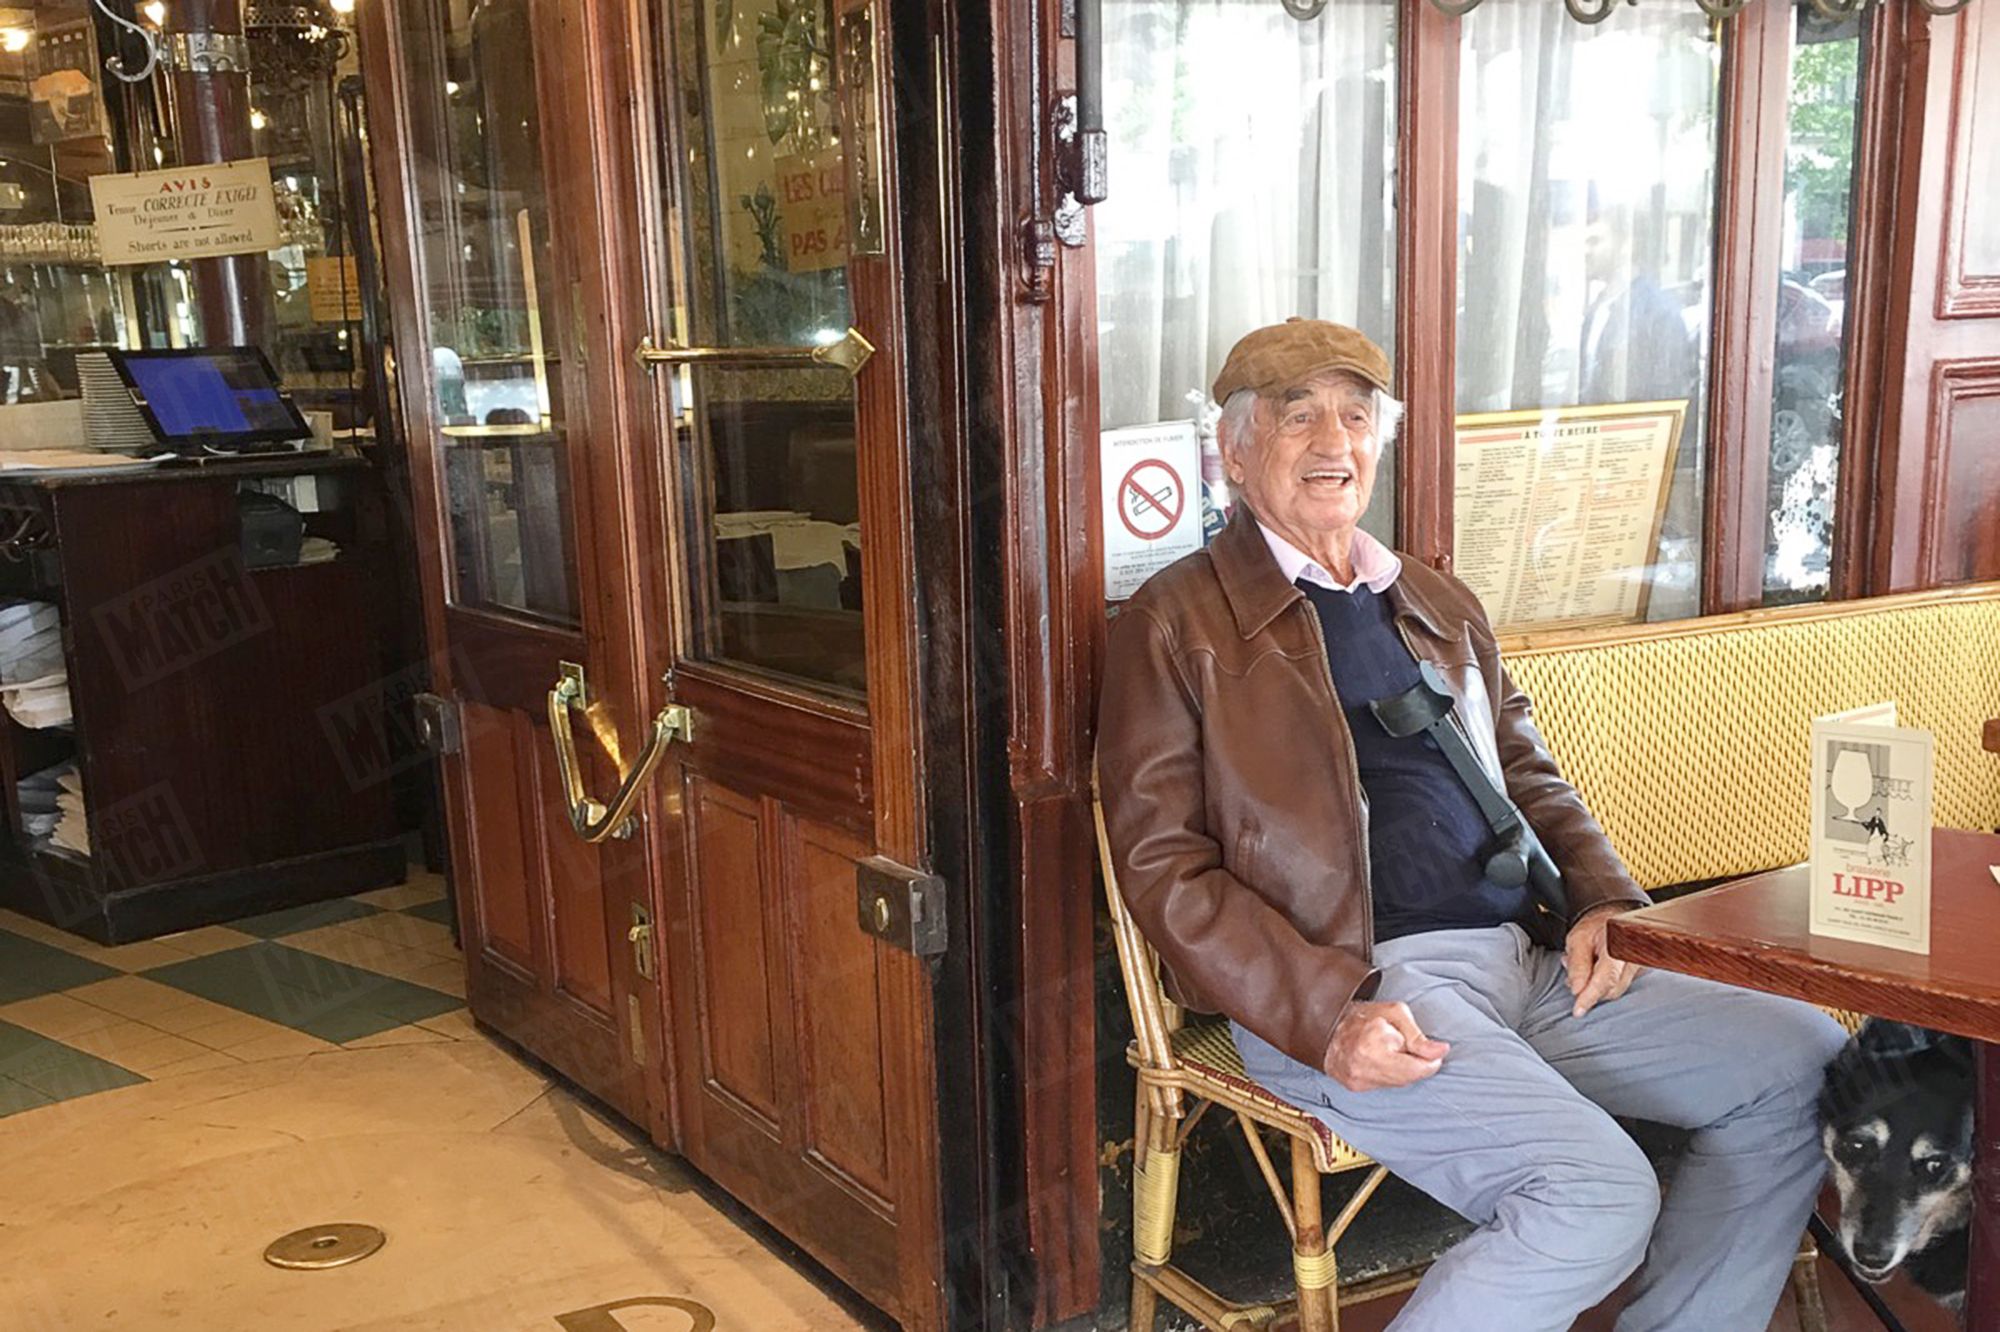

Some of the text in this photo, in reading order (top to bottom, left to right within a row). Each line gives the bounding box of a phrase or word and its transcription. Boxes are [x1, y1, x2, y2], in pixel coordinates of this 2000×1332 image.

[160, 176, 212, 194] AVIS
[784, 171, 813, 204] LES
[143, 193, 208, 213] CORRECTE
[128, 228, 253, 253] Shorts are not allowed
[791, 230, 827, 257] PAS
[1832, 872, 1905, 904] LIPP
